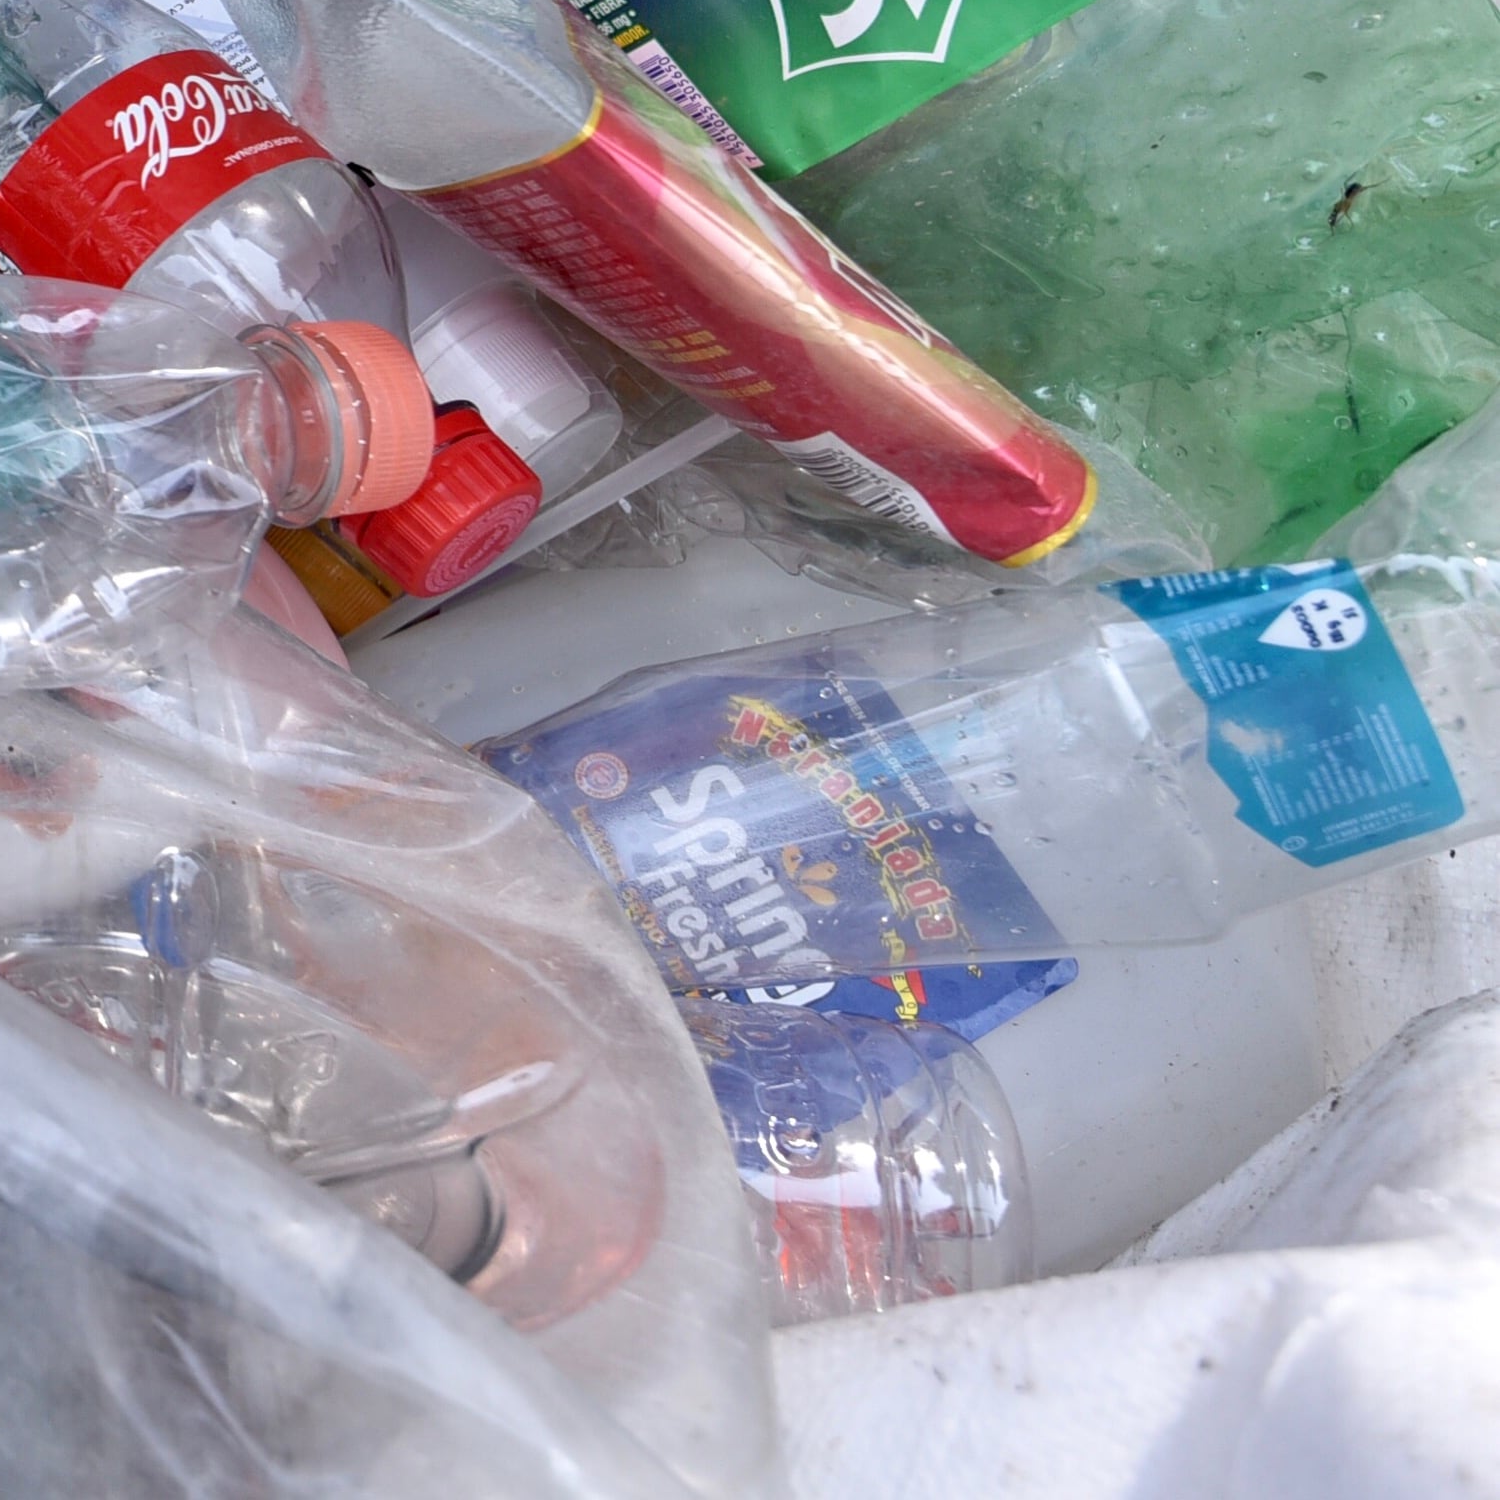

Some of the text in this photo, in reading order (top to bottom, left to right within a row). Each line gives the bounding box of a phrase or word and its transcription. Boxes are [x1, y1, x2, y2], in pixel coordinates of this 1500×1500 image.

[610, 10, 632, 32] mg
[657, 50, 701, 106] 305650
[104, 61, 275, 194] ca-Cola
[699, 98, 744, 154] 501055
[841, 693, 933, 813] BIEN ANTES DE TOMAR
[722, 673, 978, 969] Naranjada
[610, 744, 876, 1033] Spring
[630, 847, 760, 991] Fresh
